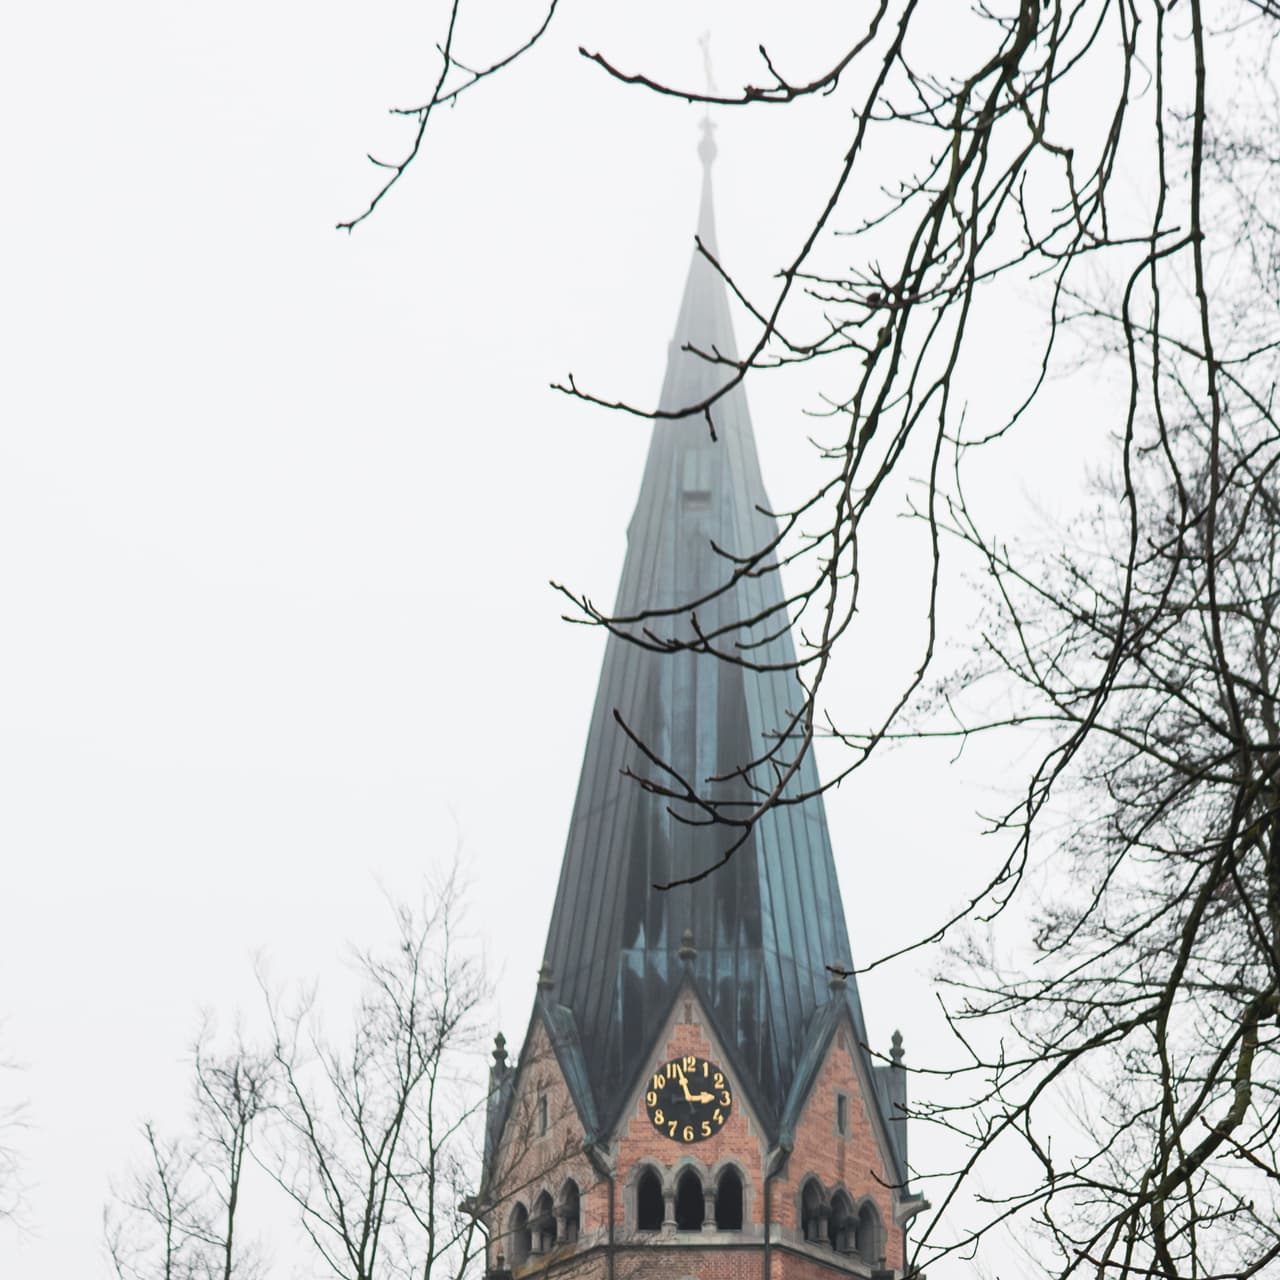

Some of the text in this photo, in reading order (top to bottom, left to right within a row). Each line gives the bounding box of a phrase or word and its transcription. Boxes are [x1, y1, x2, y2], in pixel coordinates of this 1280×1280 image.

[667, 1064, 677, 1078] 11
[683, 1056, 696, 1072] 12
[703, 1062, 708, 1078] 1
[654, 1074, 665, 1090] 10
[714, 1073, 724, 1089] 2
[647, 1091, 657, 1106] 9
[720, 1091, 731, 1106] 3
[654, 1109, 664, 1125] 8
[713, 1108, 724, 1125] 4
[668, 1121, 678, 1137] 7
[683, 1126, 694, 1141] 6
[701, 1121, 711, 1136] 5
